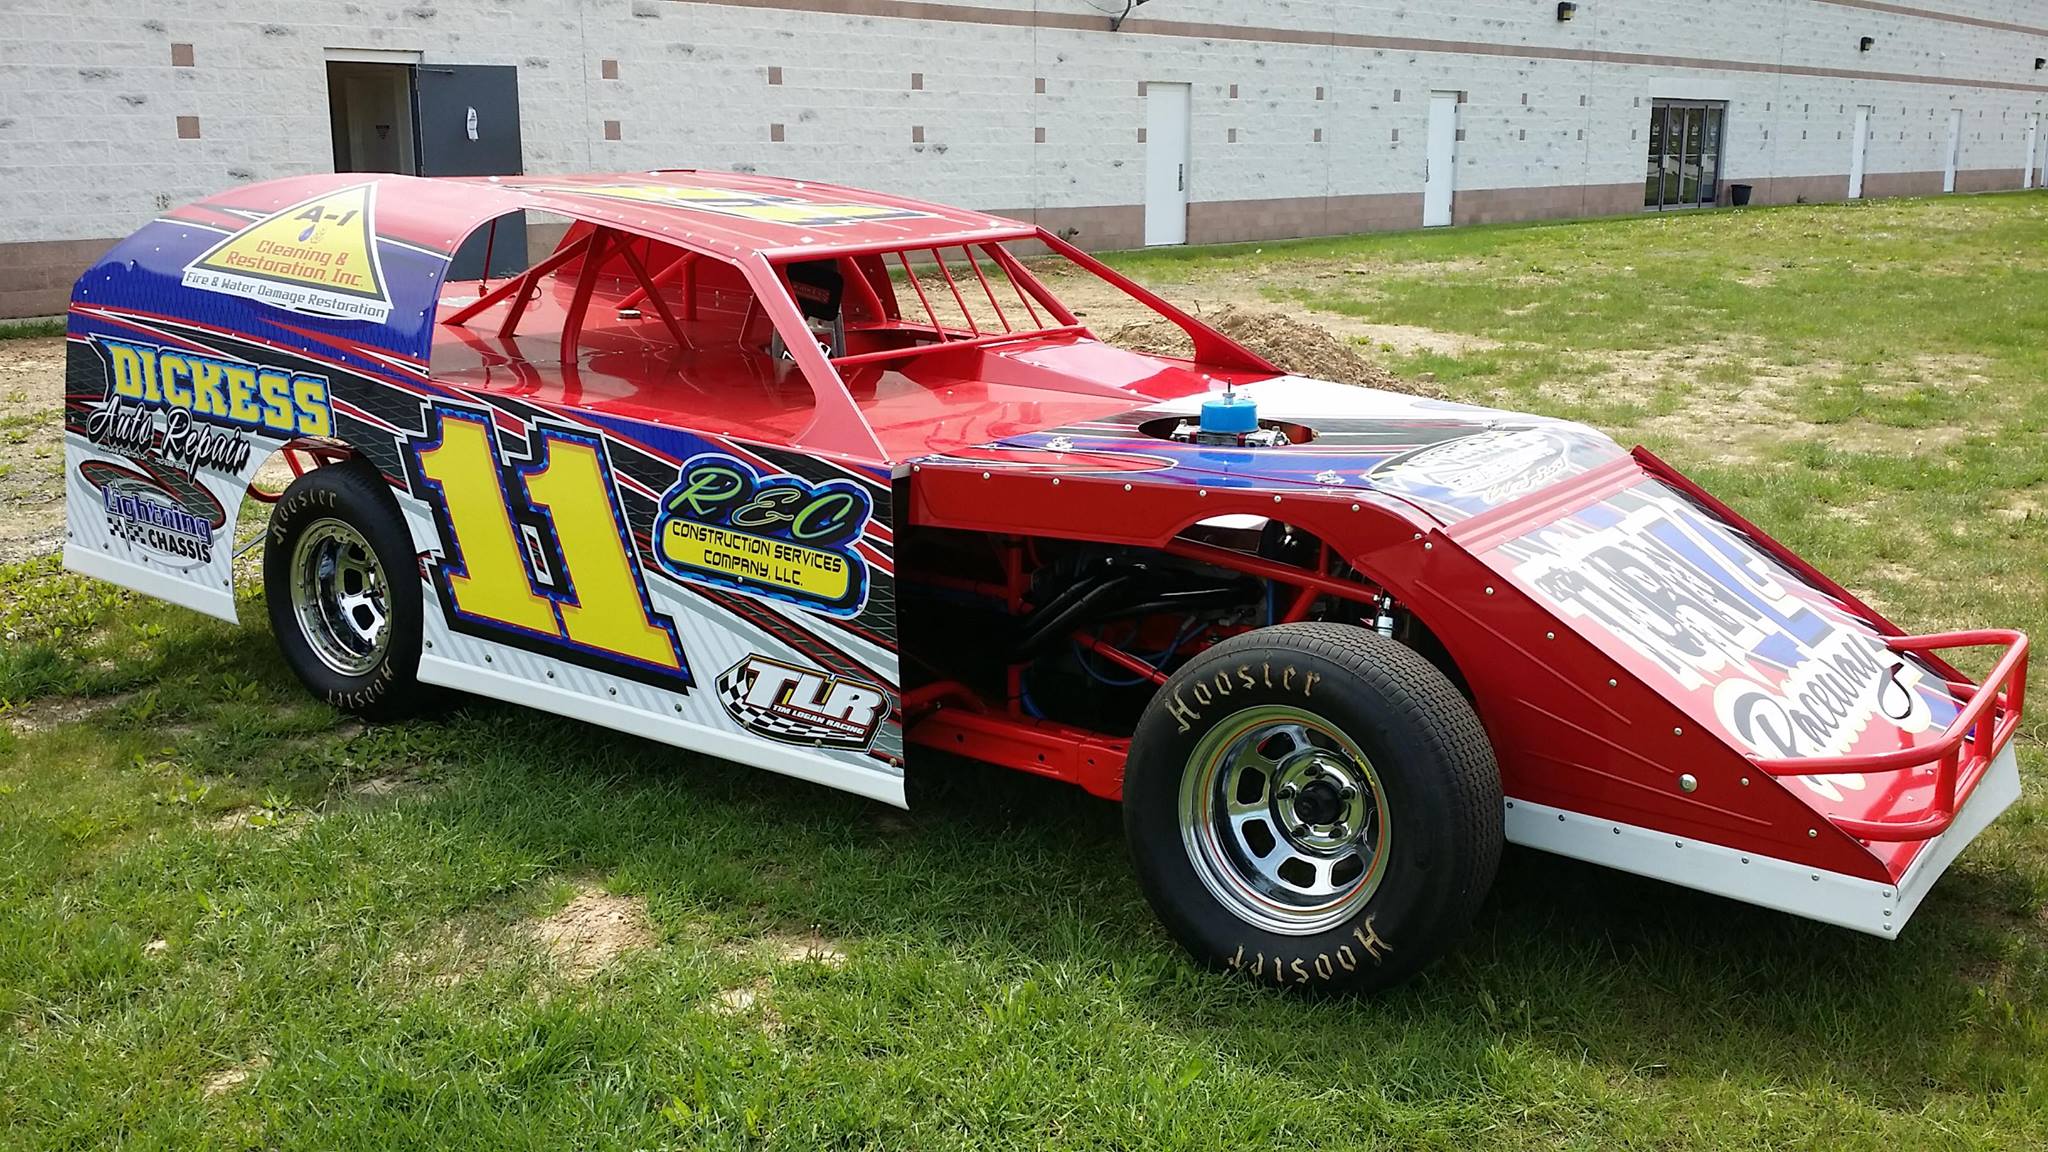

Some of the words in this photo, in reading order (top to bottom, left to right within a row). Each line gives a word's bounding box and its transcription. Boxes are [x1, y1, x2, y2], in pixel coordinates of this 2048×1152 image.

[293, 204, 359, 227] A-1
[255, 240, 333, 266] Cleaning
[334, 251, 350, 266] &
[331, 268, 364, 288] Inc.
[185, 271, 210, 286] Fire
[210, 276, 219, 287] &
[220, 278, 256, 295] Water
[257, 284, 306, 305] Damage
[307, 293, 386, 319] Restoration
[108, 342, 332, 438] DICKESS
[88, 394, 153, 449] Auto
[161, 406, 251, 478] Repair
[101, 484, 213, 546] Lightning
[270, 488, 338, 545] Hoosier
[416, 412, 684, 672] 11
[148, 528, 212, 564] CHASSIS
[703, 549, 771, 580] COMPANY,
[774, 565, 803, 586] LLC.
[327, 655, 395, 710] Hoosier
[742, 659, 882, 726] TLR
[1164, 660, 1322, 734] Hoosier
[1733, 632, 1914, 786] Raceway
[772, 704, 791, 715] TIM
[792, 709, 826, 724] LOGAN
[826, 719, 866, 735] RACING
[1226, 912, 1395, 985] Hoosier
